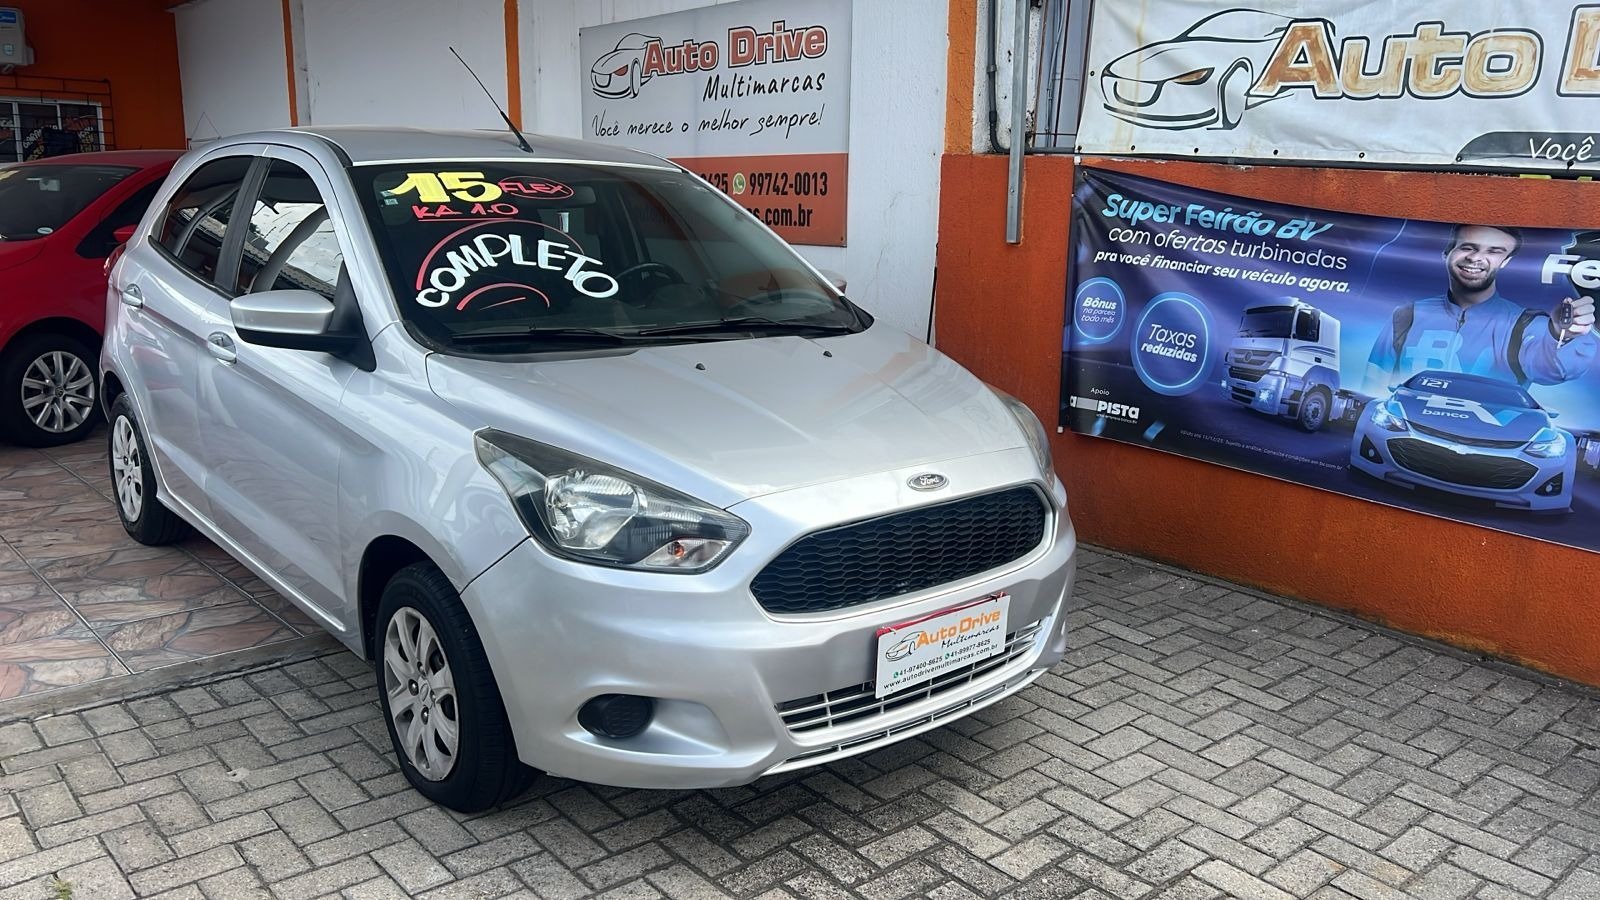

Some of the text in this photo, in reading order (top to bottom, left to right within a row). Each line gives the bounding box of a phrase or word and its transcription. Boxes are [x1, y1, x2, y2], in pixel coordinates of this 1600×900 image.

[642, 20, 828, 78] Auto Drive
[1247, 17, 1545, 99] Auto
[703, 72, 826, 102] Multimarcas
[592, 103, 825, 139] Você merece o melhor sempre!
[1529, 135, 1595, 161] Você
[388, 172, 566, 203] 15 FLEX
[749, 171, 828, 196] 99742-0013
[412, 204, 457, 218] KA
[1102, 194, 1335, 241] Super Feirão BV
[1108, 228, 1348, 270] com ofertas turbinadas
[416, 233, 619, 307] COMPLETO
[1093, 251, 1350, 293] pra você financiar seu veículo agora.
[1541, 253, 1600, 289] Fe
[1082, 297, 1117, 310] Bônus
[1149, 323, 1197, 349] Taxas
[1141, 342, 1198, 363] reduzidas
[1090, 387, 1110, 396] Apoio
[1421, 379, 1449, 389] 121
[1422, 408, 1470, 419] banco
[916, 610, 1001, 648] Auto Drive
[941, 625, 1000, 648] Multimarcas
